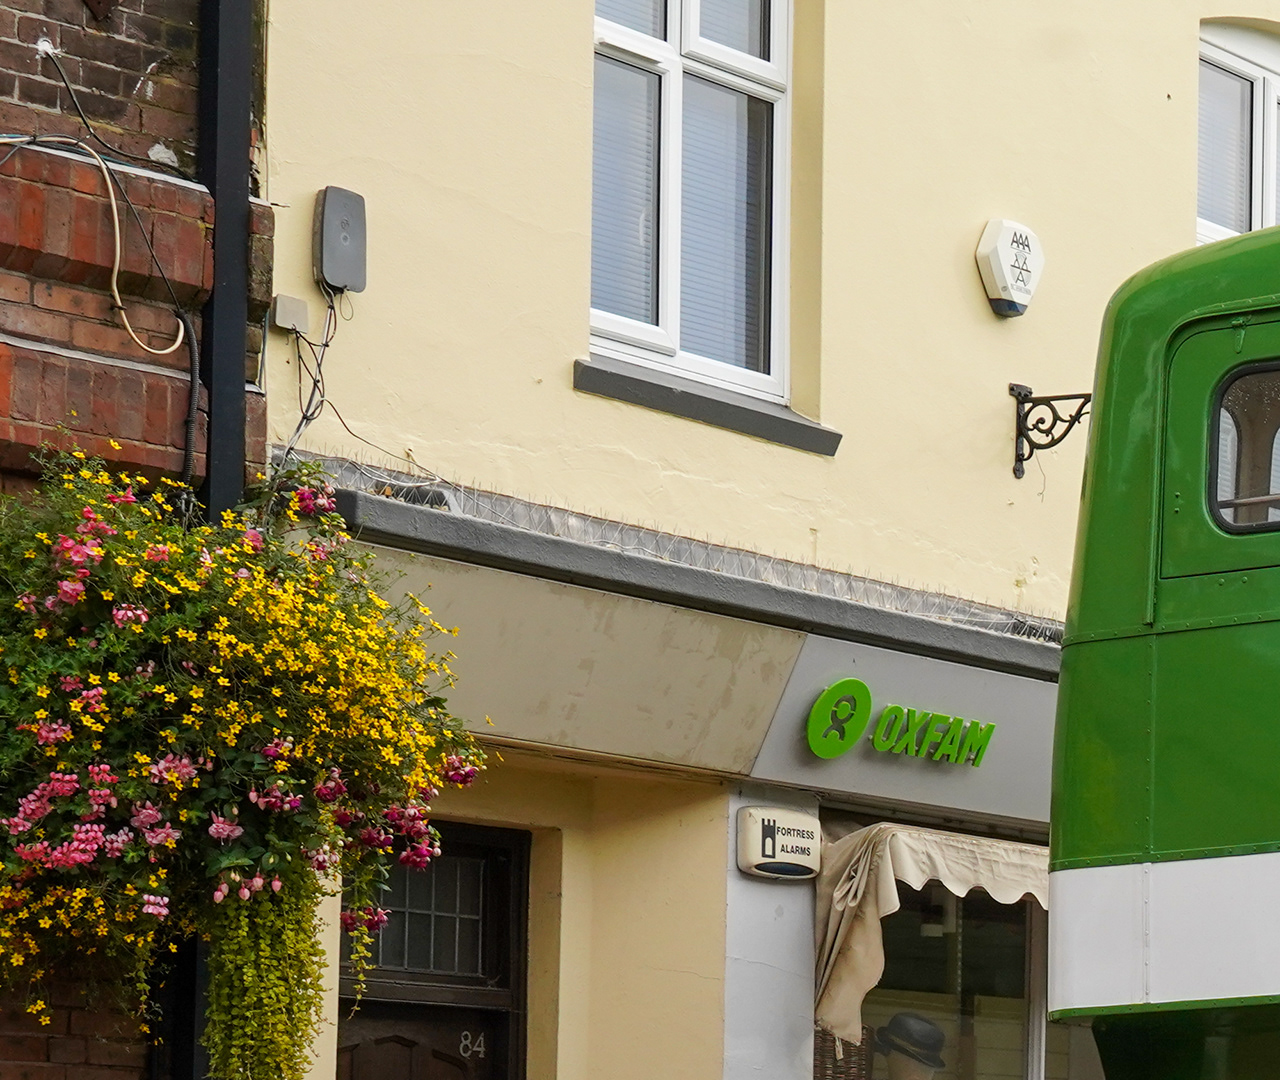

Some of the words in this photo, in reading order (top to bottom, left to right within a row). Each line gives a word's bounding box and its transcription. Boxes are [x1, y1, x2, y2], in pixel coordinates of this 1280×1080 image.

[873, 704, 996, 767] OXFAM
[776, 826, 815, 840] FORTRESS
[780, 844, 811, 856] ALARMS
[460, 1031, 486, 1059] 84
